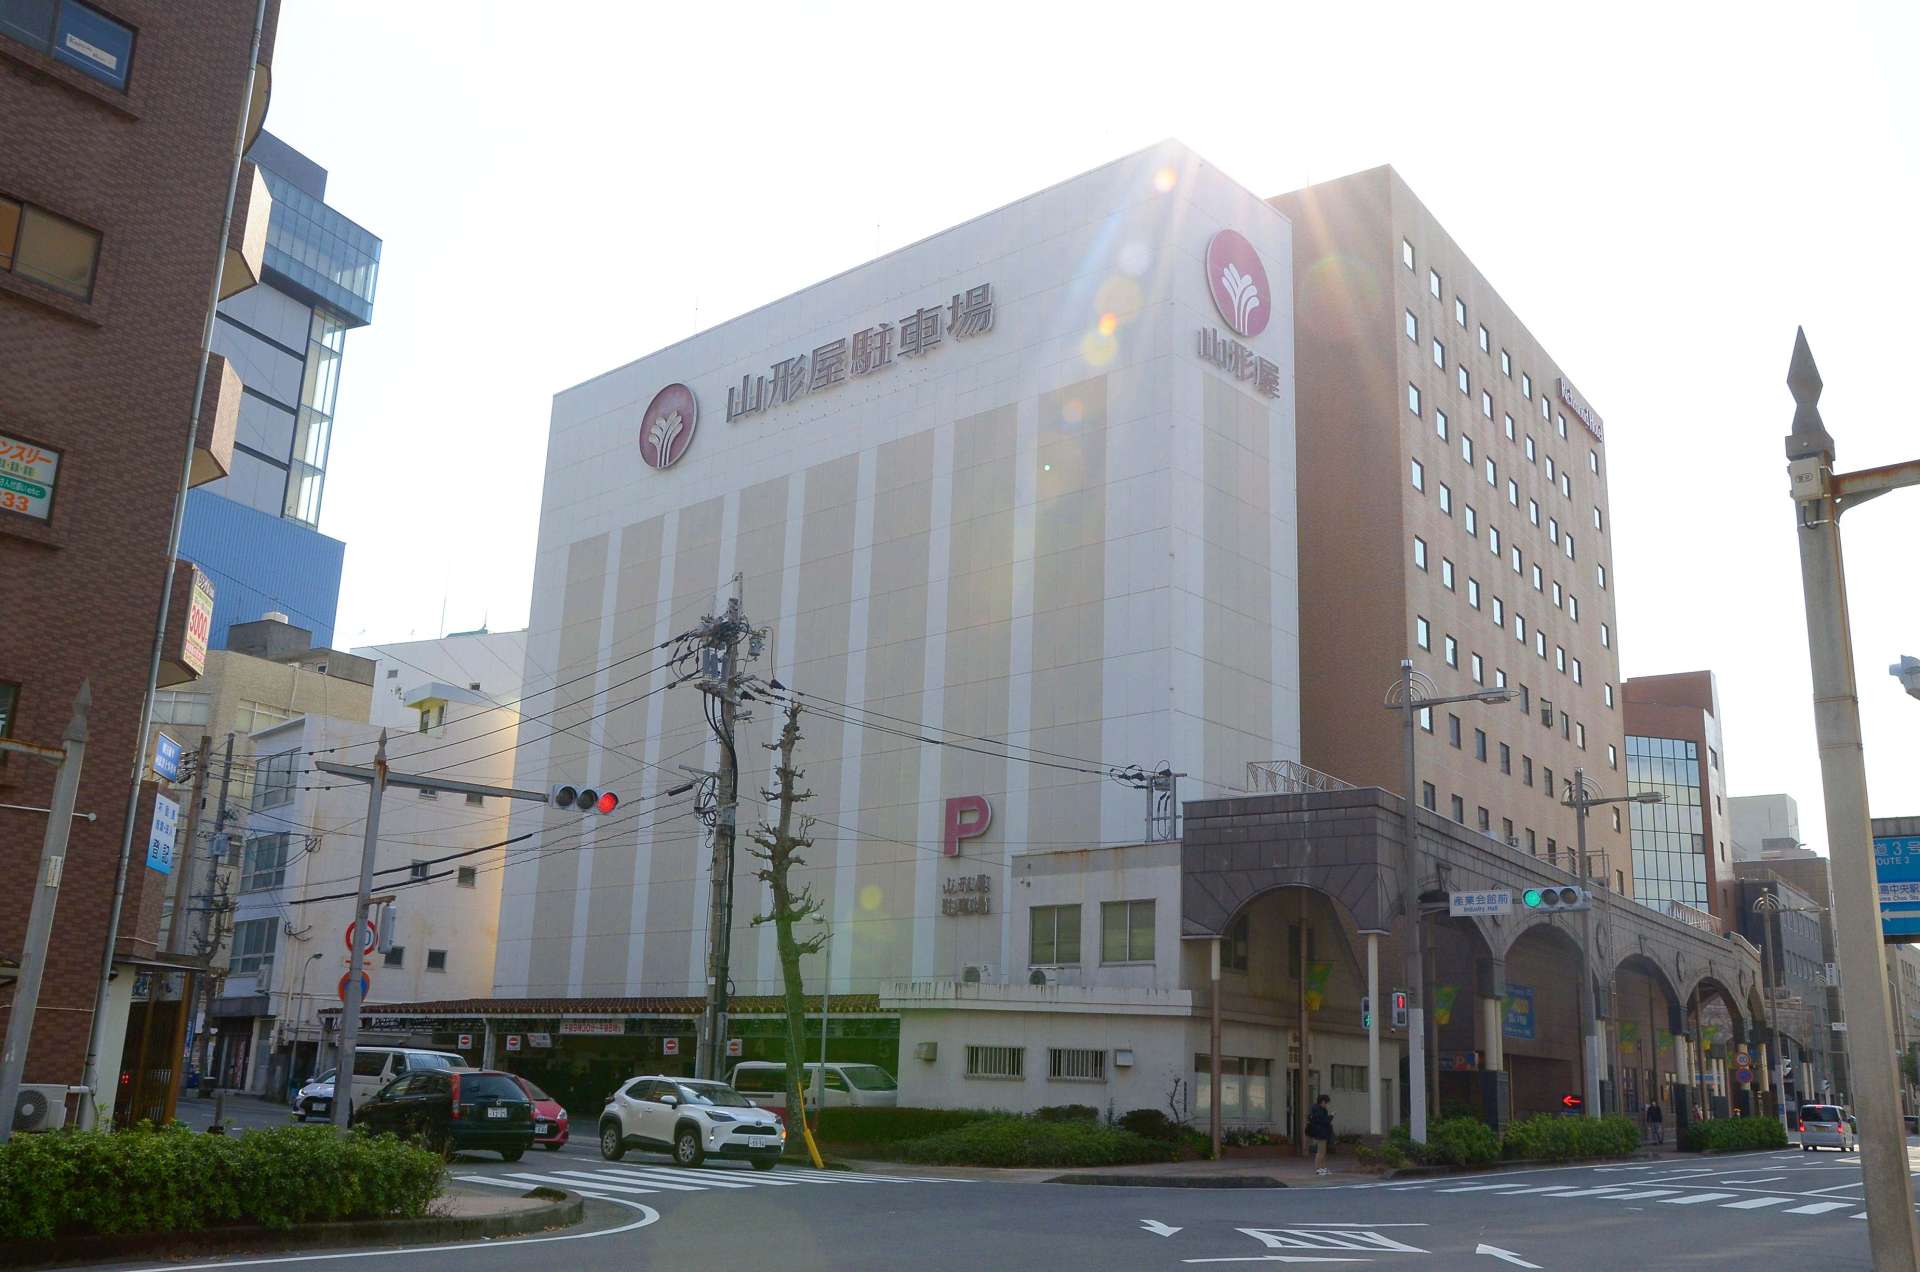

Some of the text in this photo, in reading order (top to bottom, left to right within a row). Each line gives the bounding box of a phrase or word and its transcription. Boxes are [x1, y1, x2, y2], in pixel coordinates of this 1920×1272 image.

[726, 283, 993, 424] 山形屋駐車場
[1198, 327, 1281, 399] 山形屋
[944, 795, 992, 858] P
[1455, 894, 1509, 906] 産業会館前
